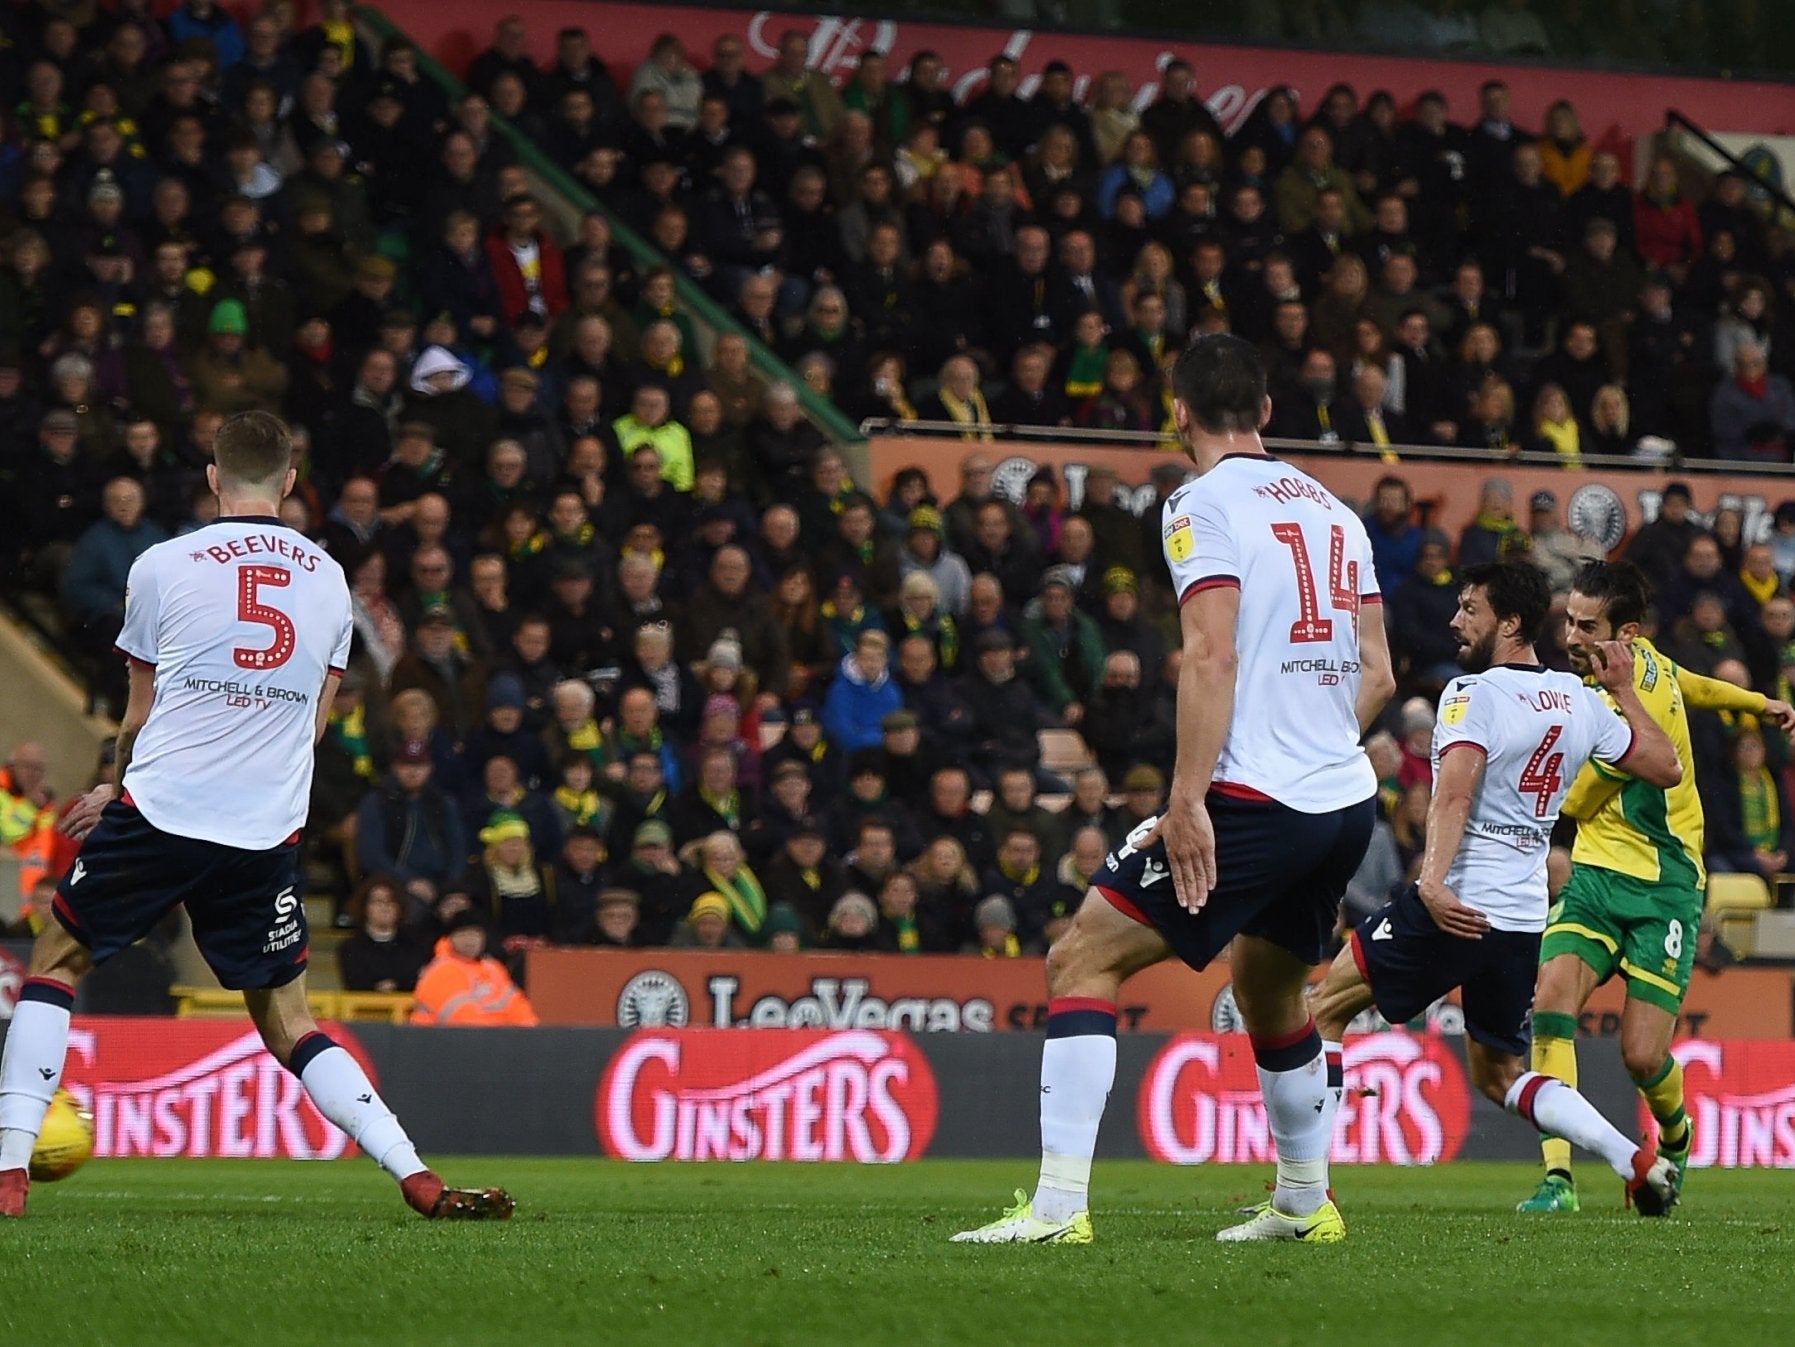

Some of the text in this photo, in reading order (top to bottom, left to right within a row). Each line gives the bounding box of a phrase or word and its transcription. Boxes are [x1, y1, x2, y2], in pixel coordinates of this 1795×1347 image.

[1265, 477, 1332, 510] HOBBS
[207, 534, 321, 572] BEEVERS
[1270, 522, 1360, 645] 14
[233, 565, 296, 671] 5
[1281, 659, 1338, 674] MITCHELL
[1318, 674, 1339, 686] LED
[184, 678, 309, 705] MITCHELL & BROWN
[226, 694, 272, 710] LED TV
[1518, 725, 1564, 817] 4
[1664, 918, 1683, 959] 8
[708, 976, 994, 1033] LeoVegas
[608, 1036, 912, 1163] GINSTERS
